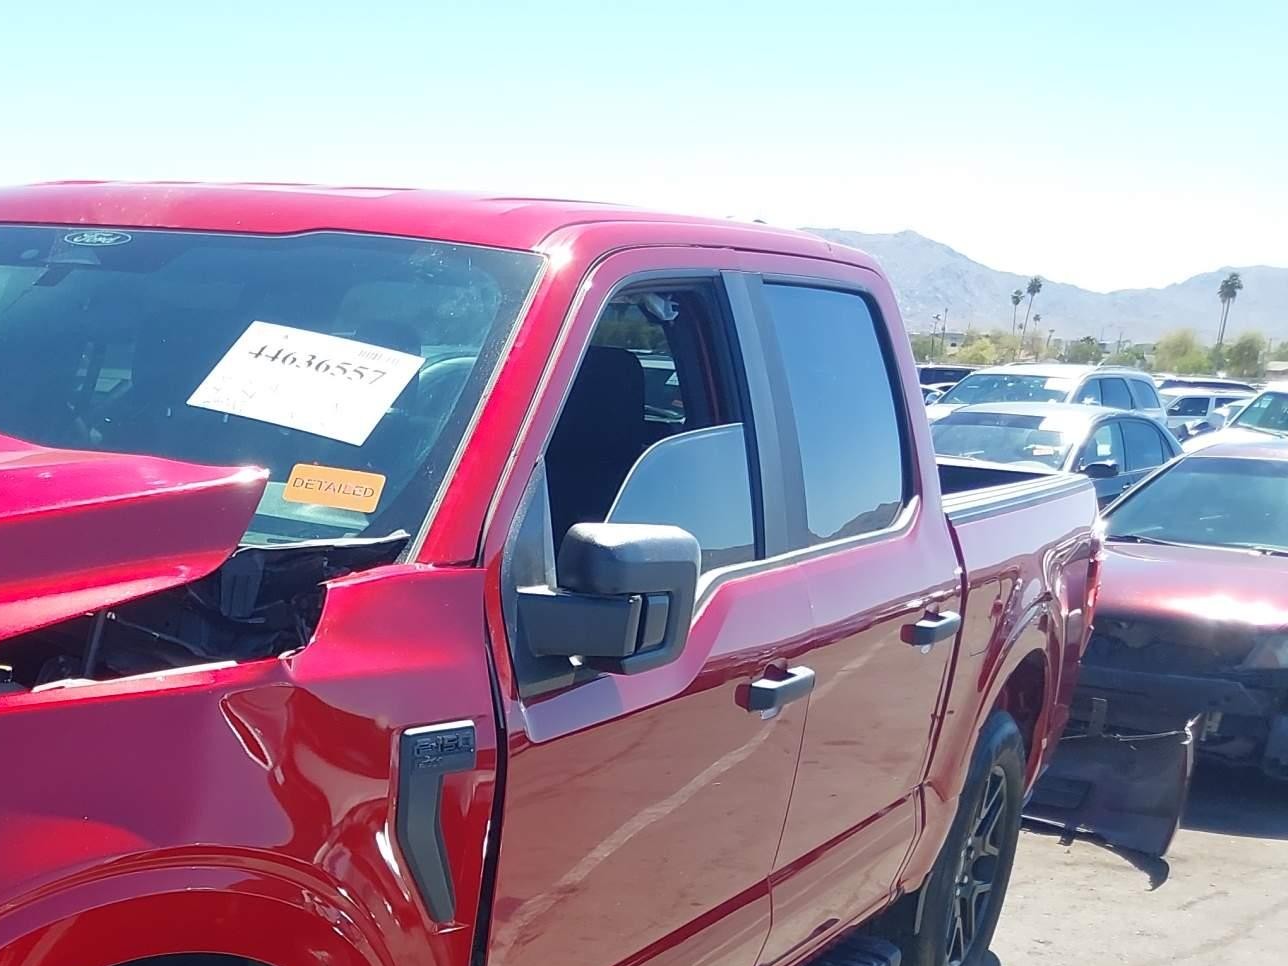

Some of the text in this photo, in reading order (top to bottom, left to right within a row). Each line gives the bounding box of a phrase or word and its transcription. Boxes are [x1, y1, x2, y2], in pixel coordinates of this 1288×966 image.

[70, 231, 125, 245] Ford
[248, 344, 387, 385] 44636557
[292, 477, 375, 498] DETAILED
